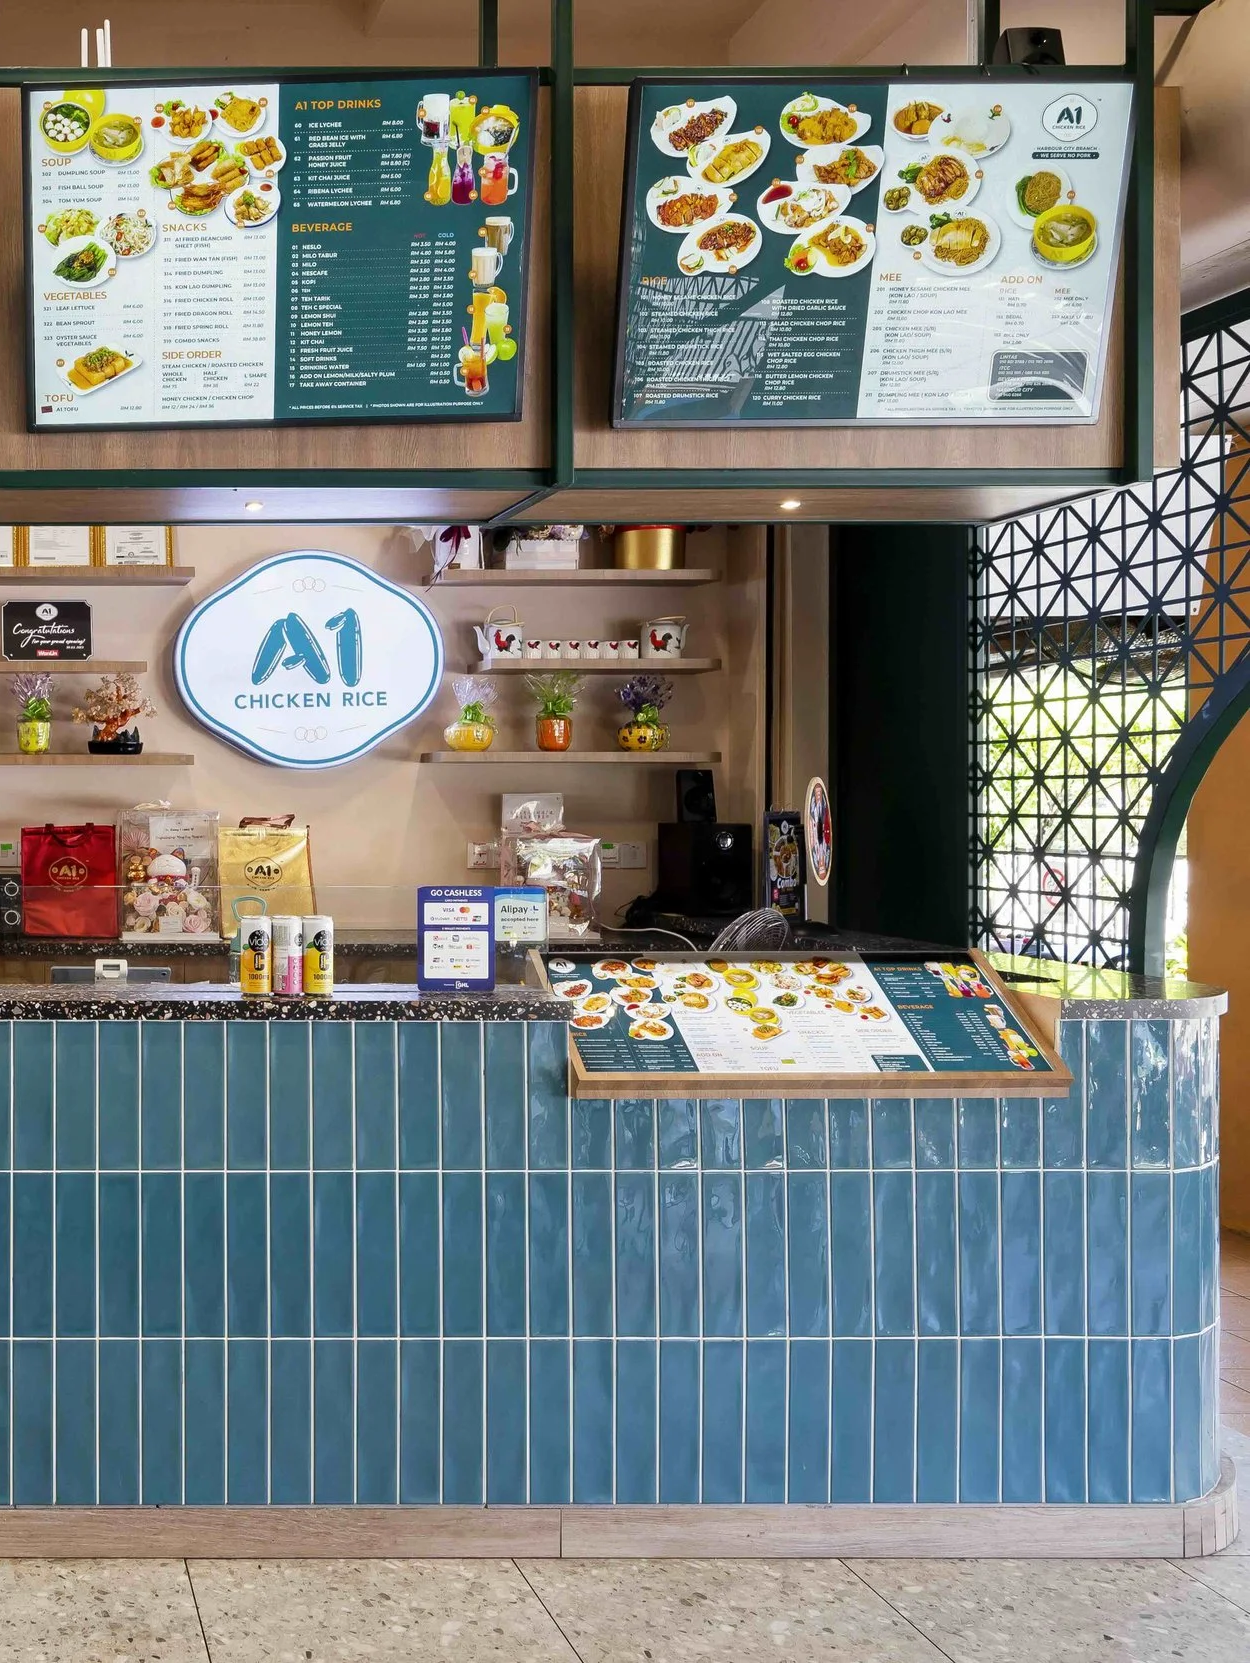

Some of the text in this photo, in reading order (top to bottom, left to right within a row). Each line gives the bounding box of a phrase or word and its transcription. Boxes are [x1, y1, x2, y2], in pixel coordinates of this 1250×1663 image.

[295, 99, 381, 110] A1 TOP DRINKS
[1057, 106, 1082, 124] A1
[42, 158, 71, 166] SOUP
[163, 223, 207, 232] SNACKS
[292, 223, 352, 232] BEVERAGE
[44, 291, 107, 300] VEGETABLES
[162, 351, 222, 359] SIDE ORDER
[45, 394, 73, 402] TOFU
[13, 622, 74, 648] Congratulations
[251, 608, 362, 687] A1
[234, 691, 387, 709] CHICKEN RICE
[59, 865, 76, 877] A1
[255, 865, 271, 876] A1
[501, 905, 528, 914] Alipay
[254, 952, 264, 971] C
[319, 952, 329, 971] C
